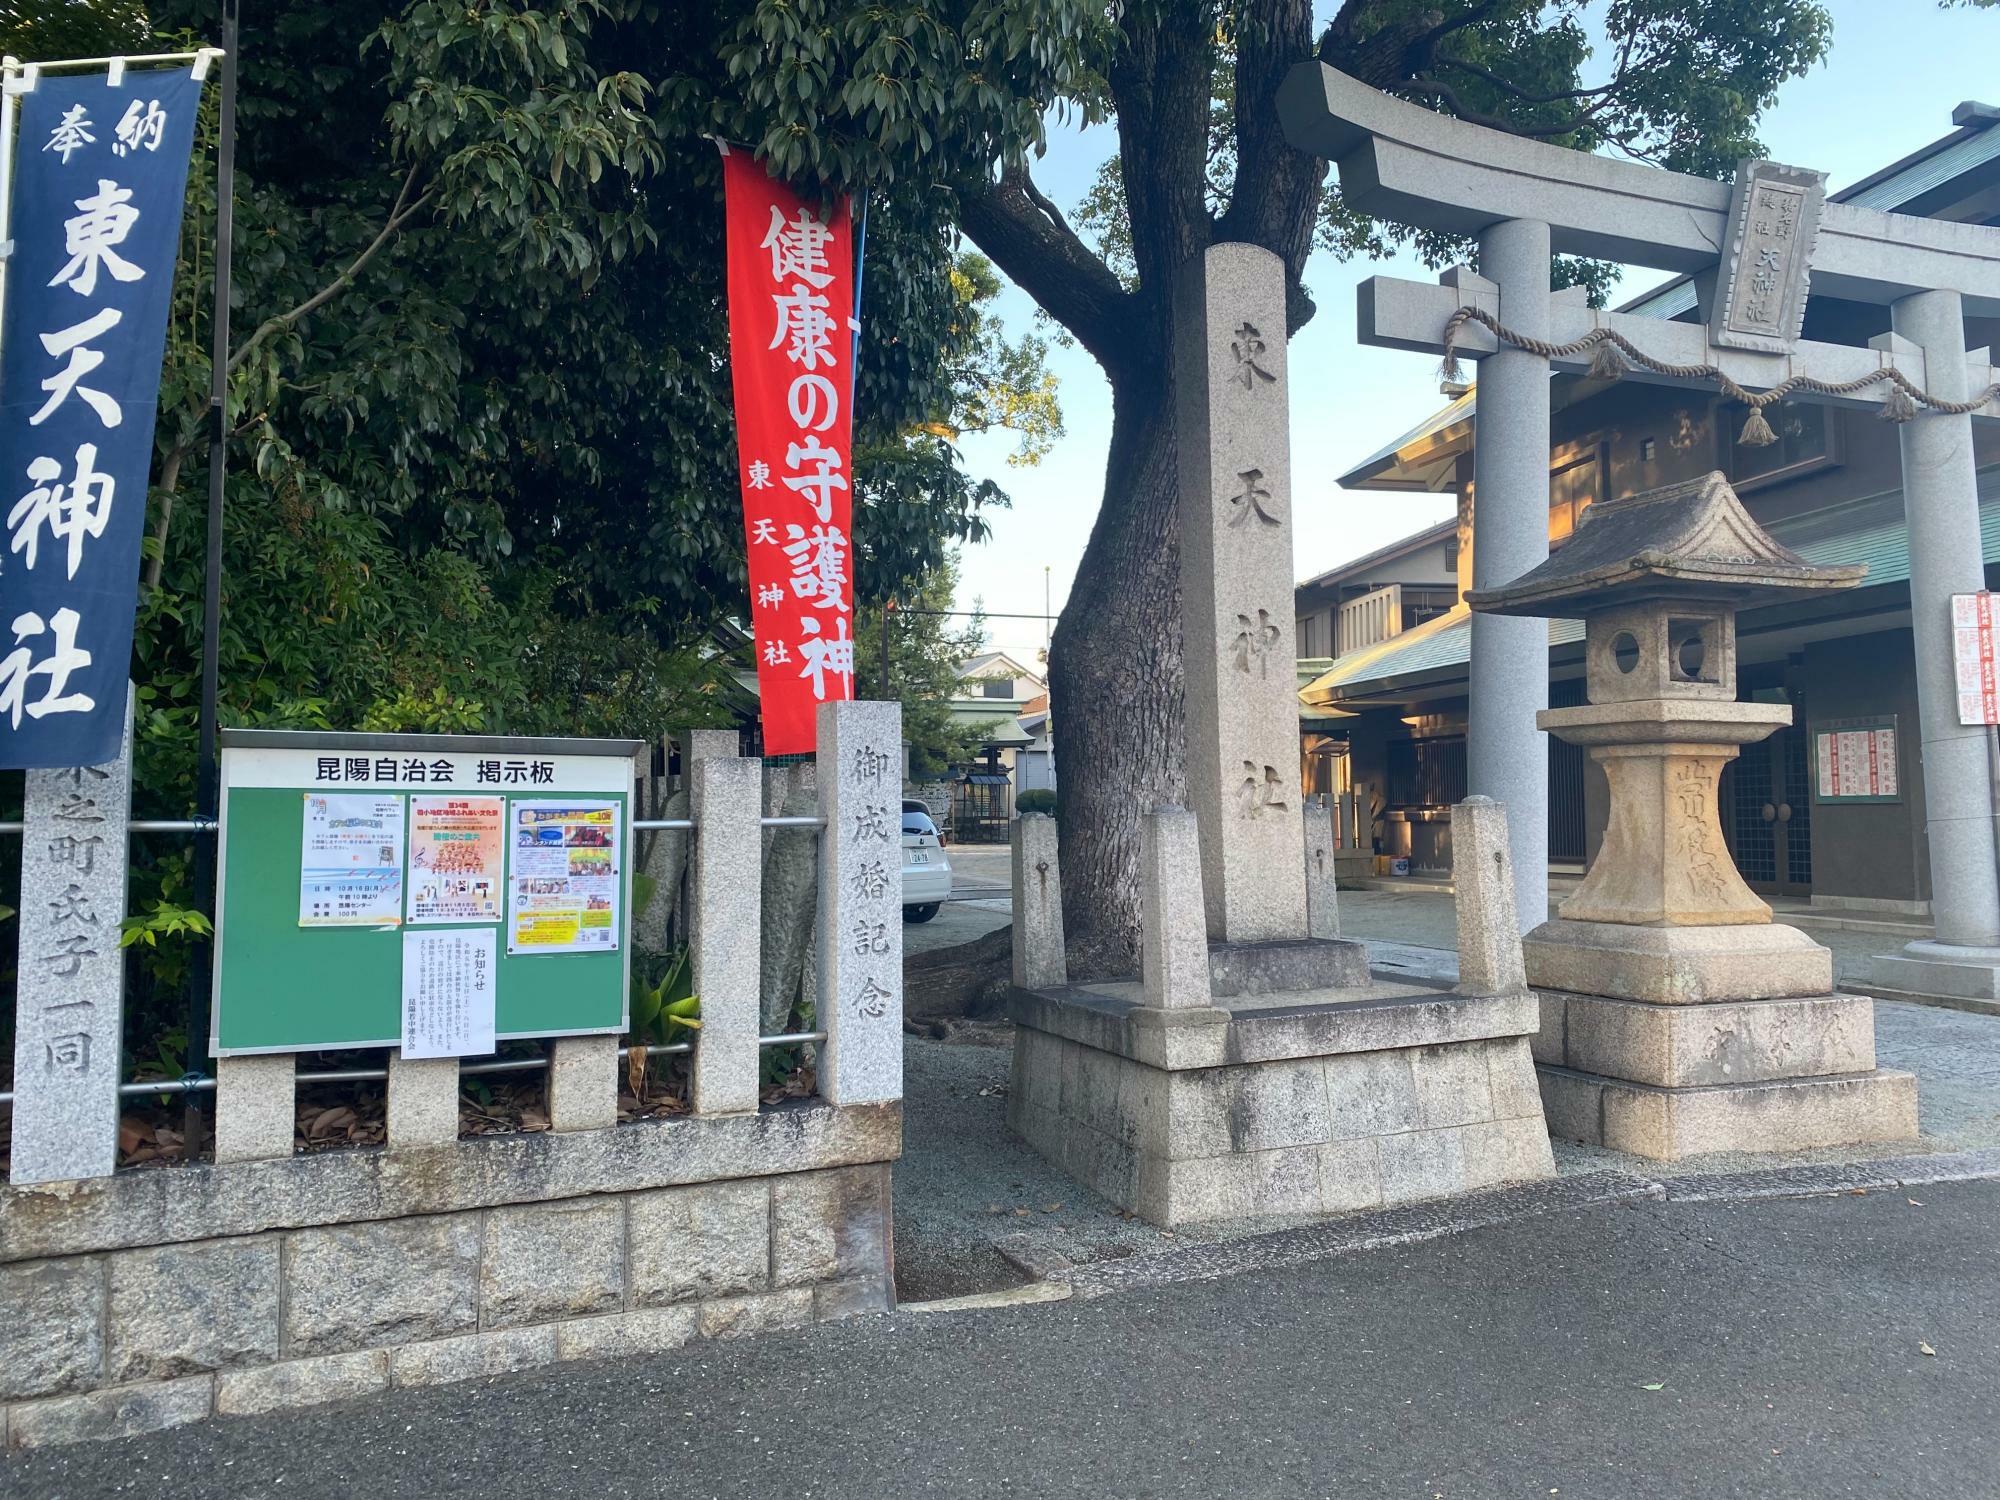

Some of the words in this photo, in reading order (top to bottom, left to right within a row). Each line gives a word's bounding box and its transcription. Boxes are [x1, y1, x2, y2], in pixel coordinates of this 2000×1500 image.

[42, 98, 167, 164] 奉納
[0, 180, 146, 731] 東天神社
[747, 460, 791, 666] 東天神社
[760, 204, 854, 700] 健康の守護神
[1228, 322, 1288, 821] 東天神社
[315, 757, 455, 783] 昆陽自治会
[477, 760, 555, 784] 掲示板
[850, 745, 892, 1019] 御成婚記念
[474, 948, 486, 991] お知らせ
